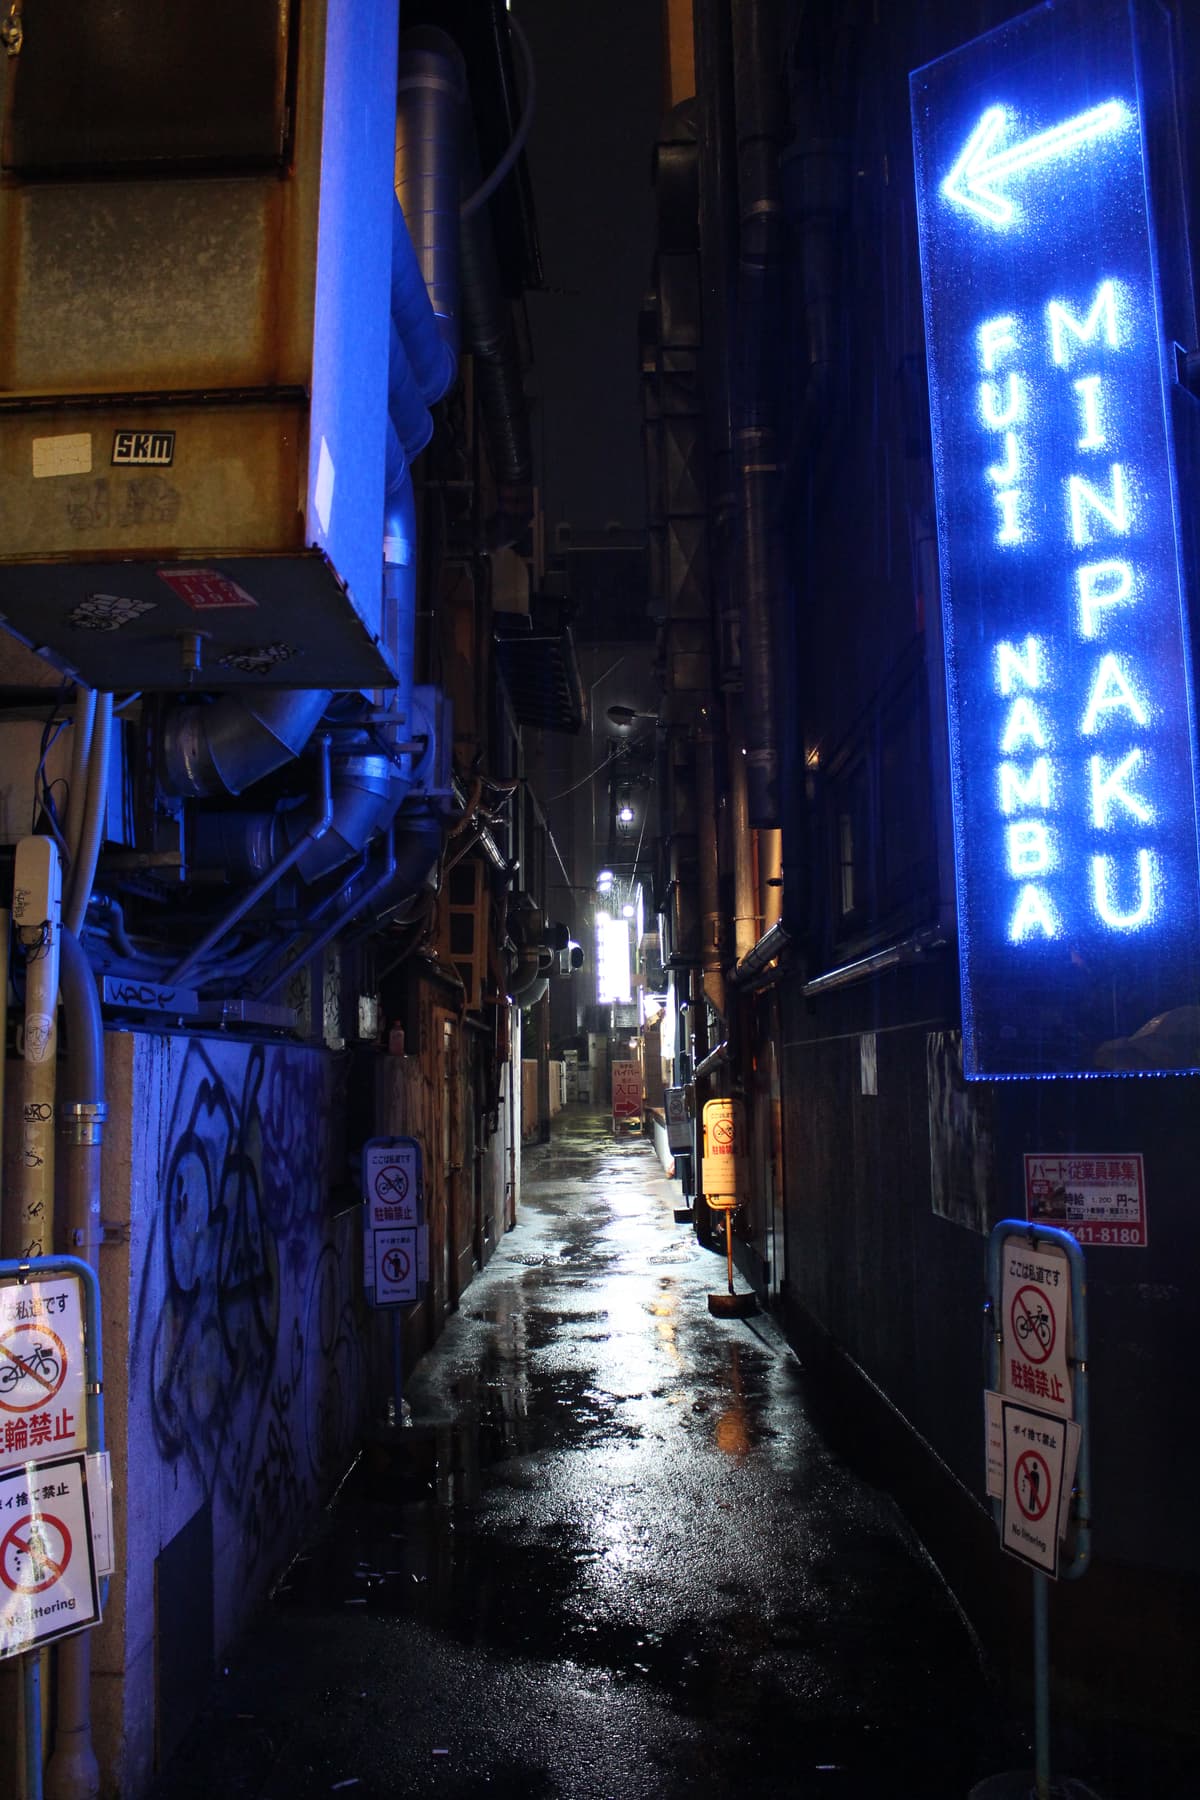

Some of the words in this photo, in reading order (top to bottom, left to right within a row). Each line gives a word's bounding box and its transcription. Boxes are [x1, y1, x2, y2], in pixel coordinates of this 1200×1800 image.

[979, 314, 1025, 542] FUJI
[115, 433, 174, 460] SKM
[1046, 278, 1153, 929] MINPAKU
[998, 636, 1061, 942] NAMBA
[615, 1084, 638, 1095] 入口
[1009, 1260, 1061, 1287] ここは私道です
[1010, 1359, 1065, 1403] 駐輪禁止
[1013, 1424, 1057, 1449] ポイ捨て禁止
[1012, 1523, 1022, 1537] No
[1021, 1527, 1047, 1553] littering
[27, 1598, 76, 1620] ittering
